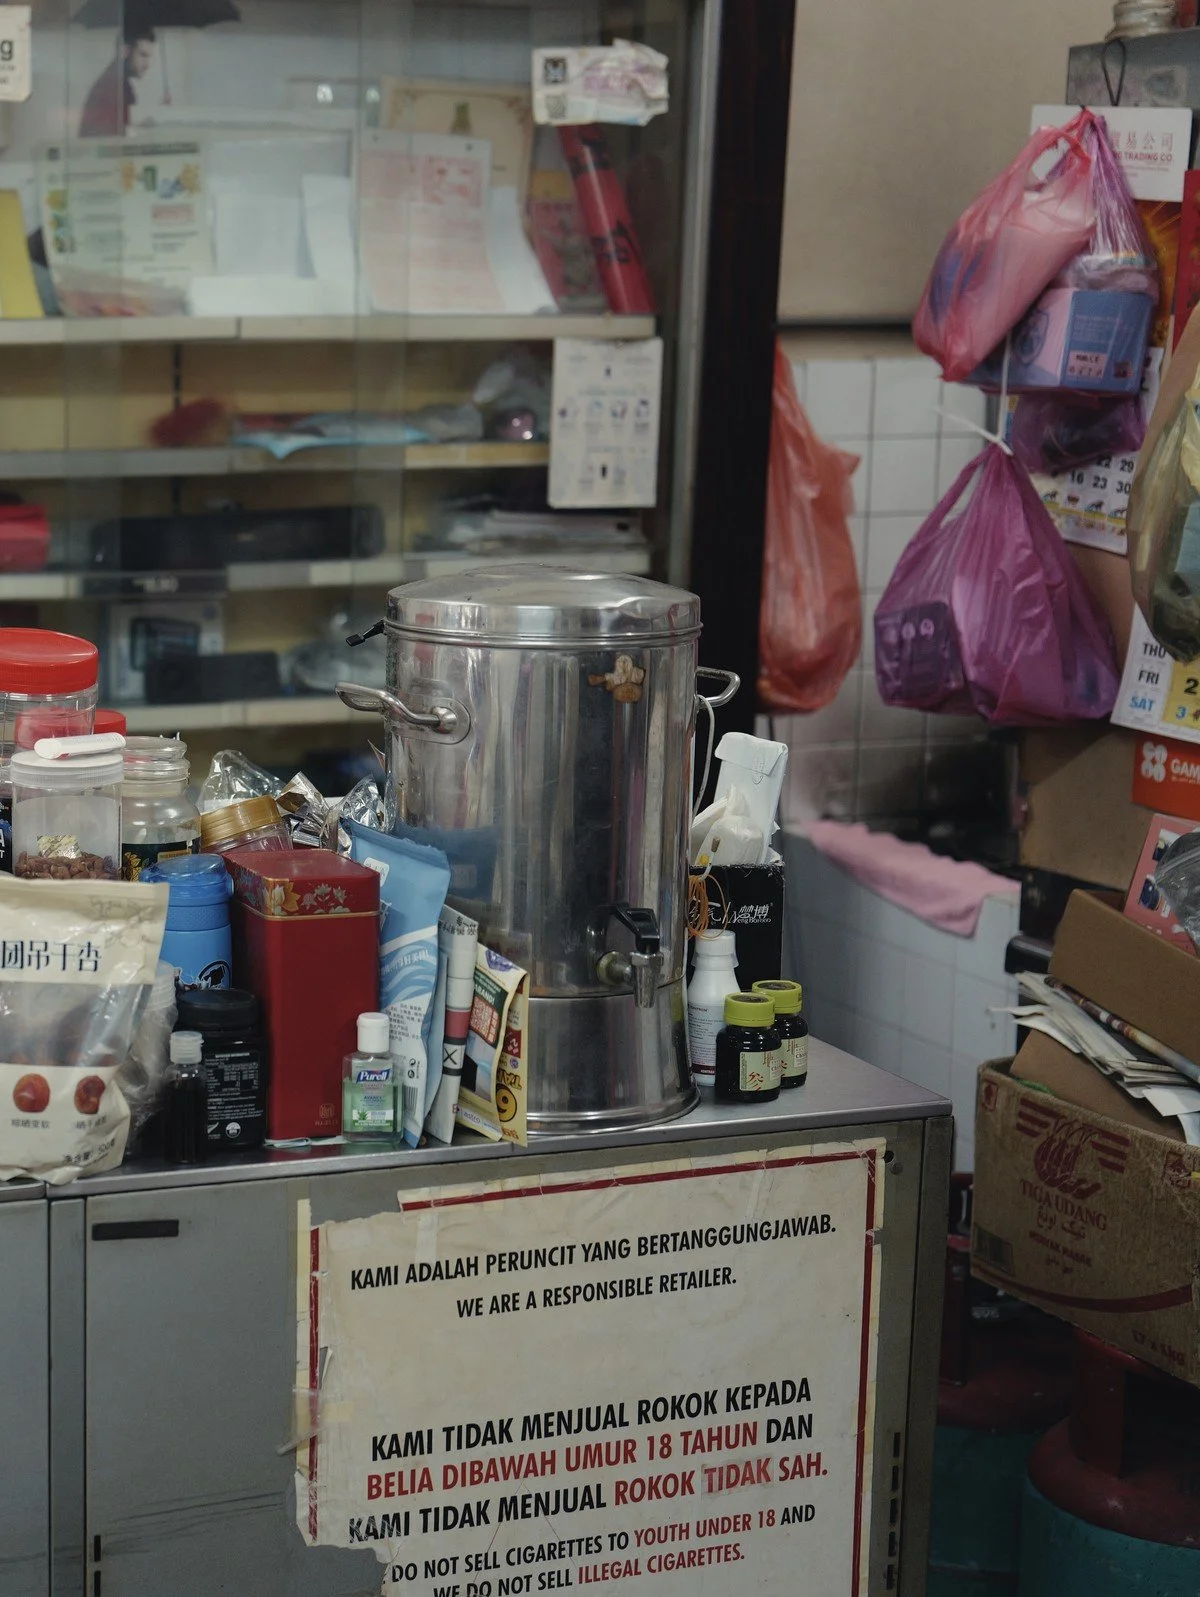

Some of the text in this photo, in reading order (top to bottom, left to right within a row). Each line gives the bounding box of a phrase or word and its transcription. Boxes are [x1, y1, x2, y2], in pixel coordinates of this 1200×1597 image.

[1093, 475, 1108, 489] 23
[1116, 480, 1131, 494] 30
[1142, 641, 1167, 659] THU
[1129, 695, 1155, 711] SAT
[1137, 669, 1159, 685] FRI
[360, 1070, 388, 1081] Purell
[1021, 1178, 1108, 1231] TIGA UDANG
[350, 1214, 836, 1291] KAMI ADALAH PERUNCIT YANG BERTANGGUNGJAWAB.
[457, 1266, 737, 1319] WE ARE A RESPONSIBLE RETAILER.
[371, 1377, 811, 1462] KAMI TIDAK MENJUAL ROKOK KEPADA
[367, 1414, 814, 1500] BELIA DIBAWAH UMUR 18 TAHUN DAN
[349, 1452, 829, 1543] KAMI TIDAK MENJUAL ROKOK TIDAK SAH.
[392, 1504, 816, 1583] DO NOT SELL CIGARETTES TO YOUTH UNDER 18 AND
[467, 1581, 493, 1597] DO
[498, 1574, 532, 1597] NOT
[537, 1568, 573, 1591] SELL
[577, 1558, 641, 1586] ILLEGAL
[646, 1542, 745, 1577] CIGARETTES.
